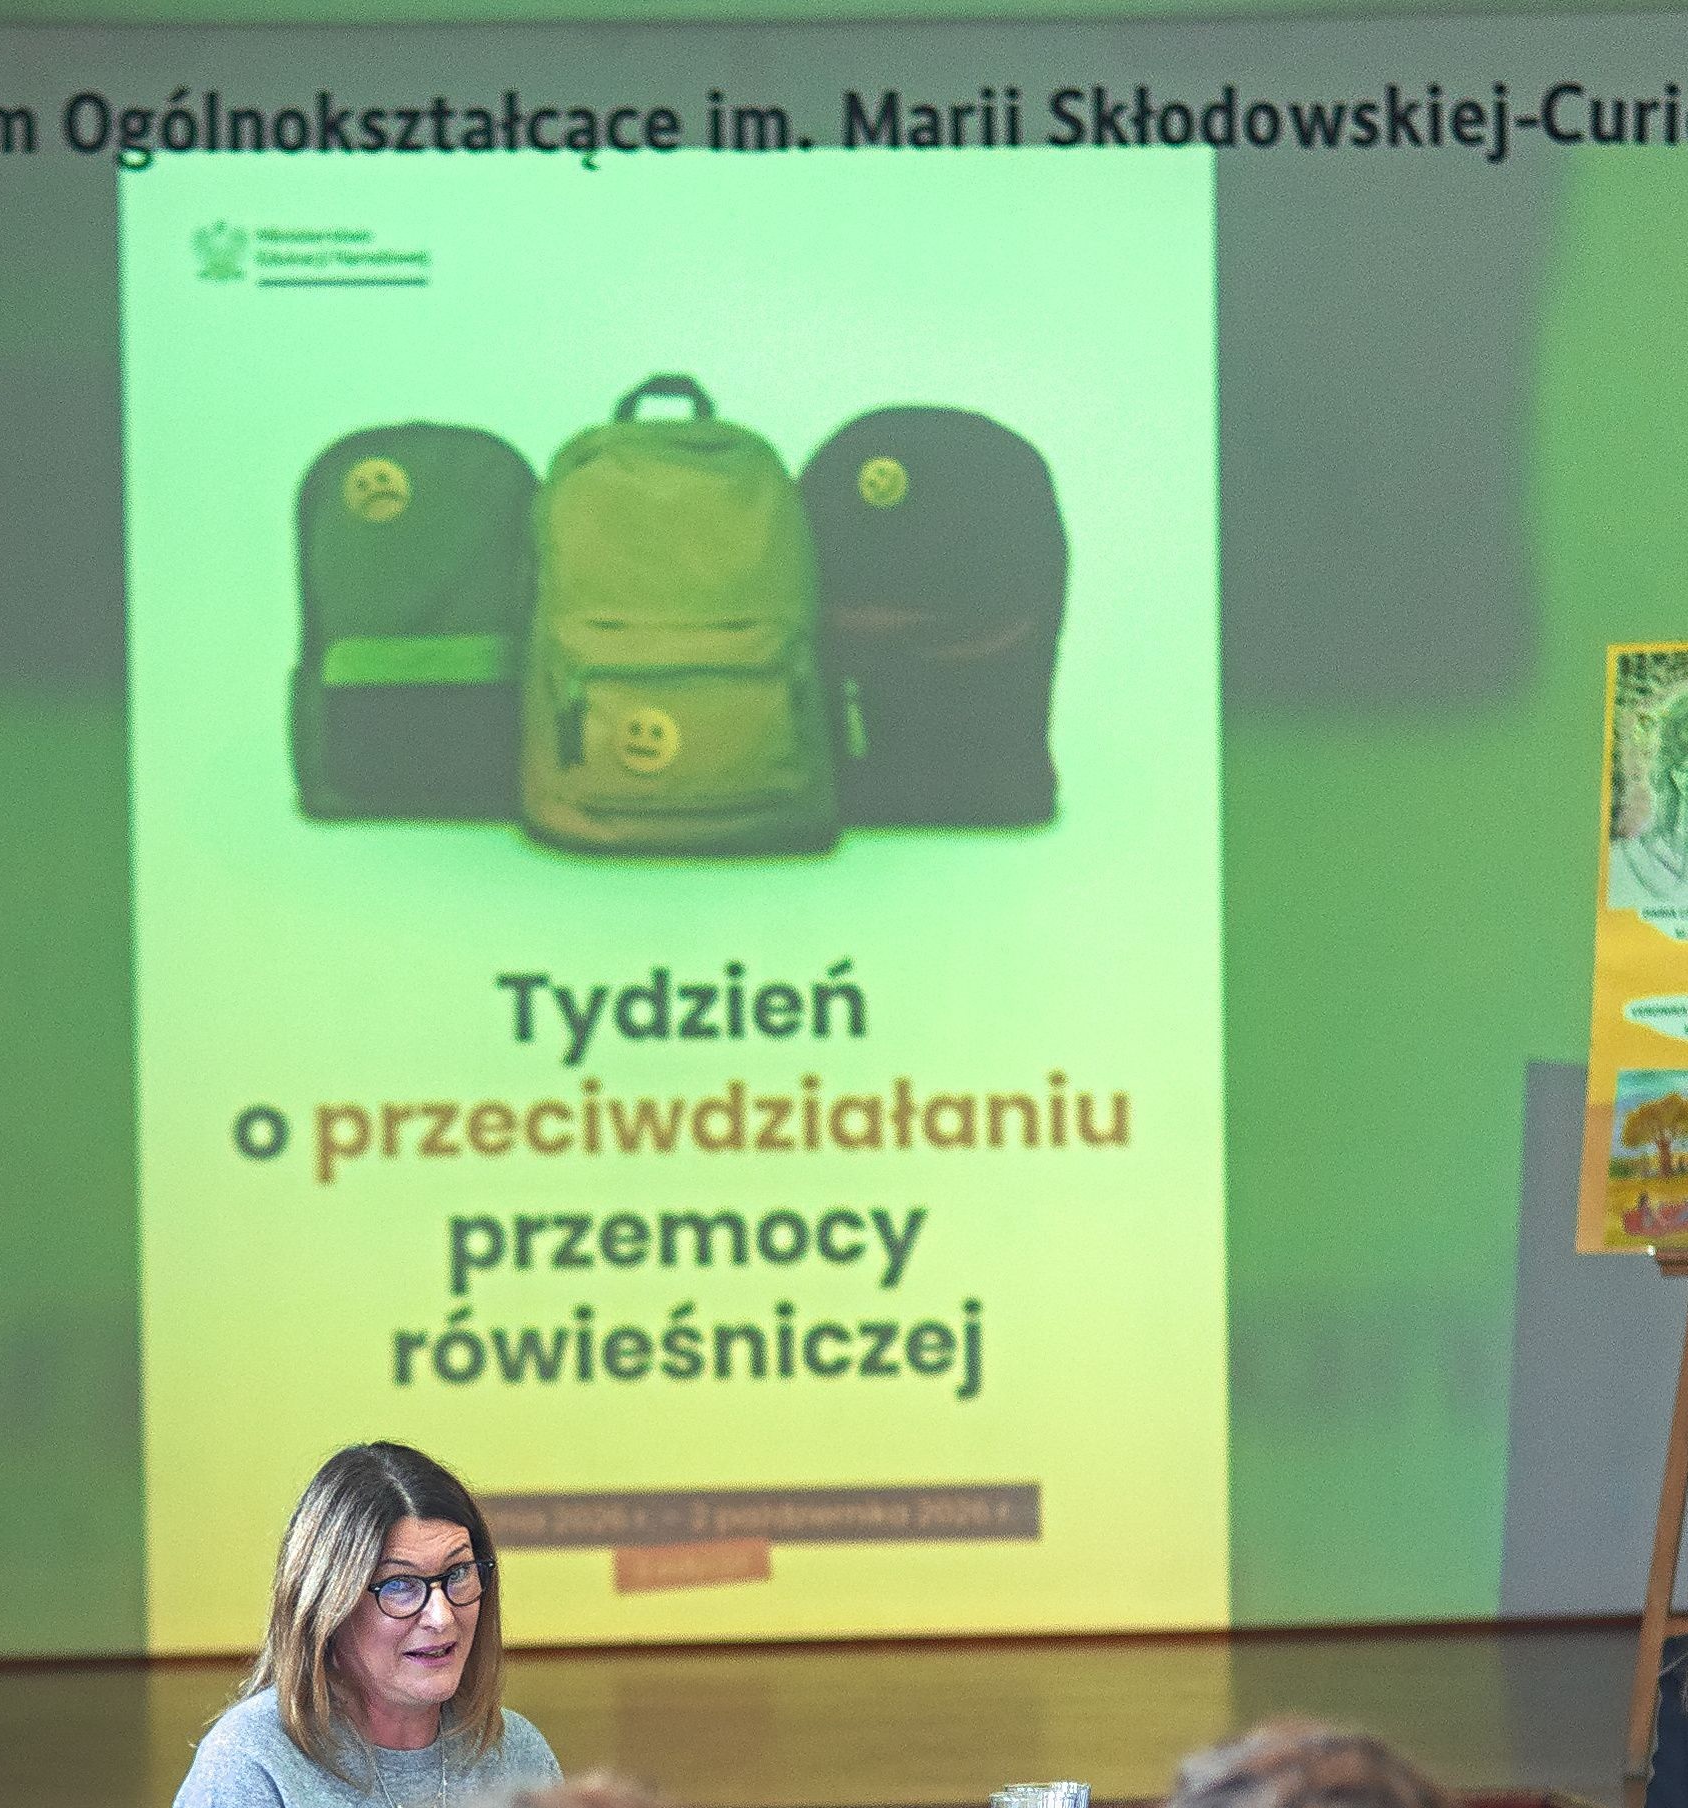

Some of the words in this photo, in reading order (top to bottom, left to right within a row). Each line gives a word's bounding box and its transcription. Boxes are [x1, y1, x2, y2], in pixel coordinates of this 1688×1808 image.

[61, 86, 682, 172] Ogólnokształcące
[707, 89, 813, 152] im.
[843, 87, 1022, 150] Marii
[497, 957, 867, 1068] Tydzień
[231, 1103, 292, 1163] o
[317, 1069, 1132, 1184] przeciwdziałaniu
[447, 1204, 929, 1297] przemocy
[391, 1297, 987, 1400] rówieśniczej
